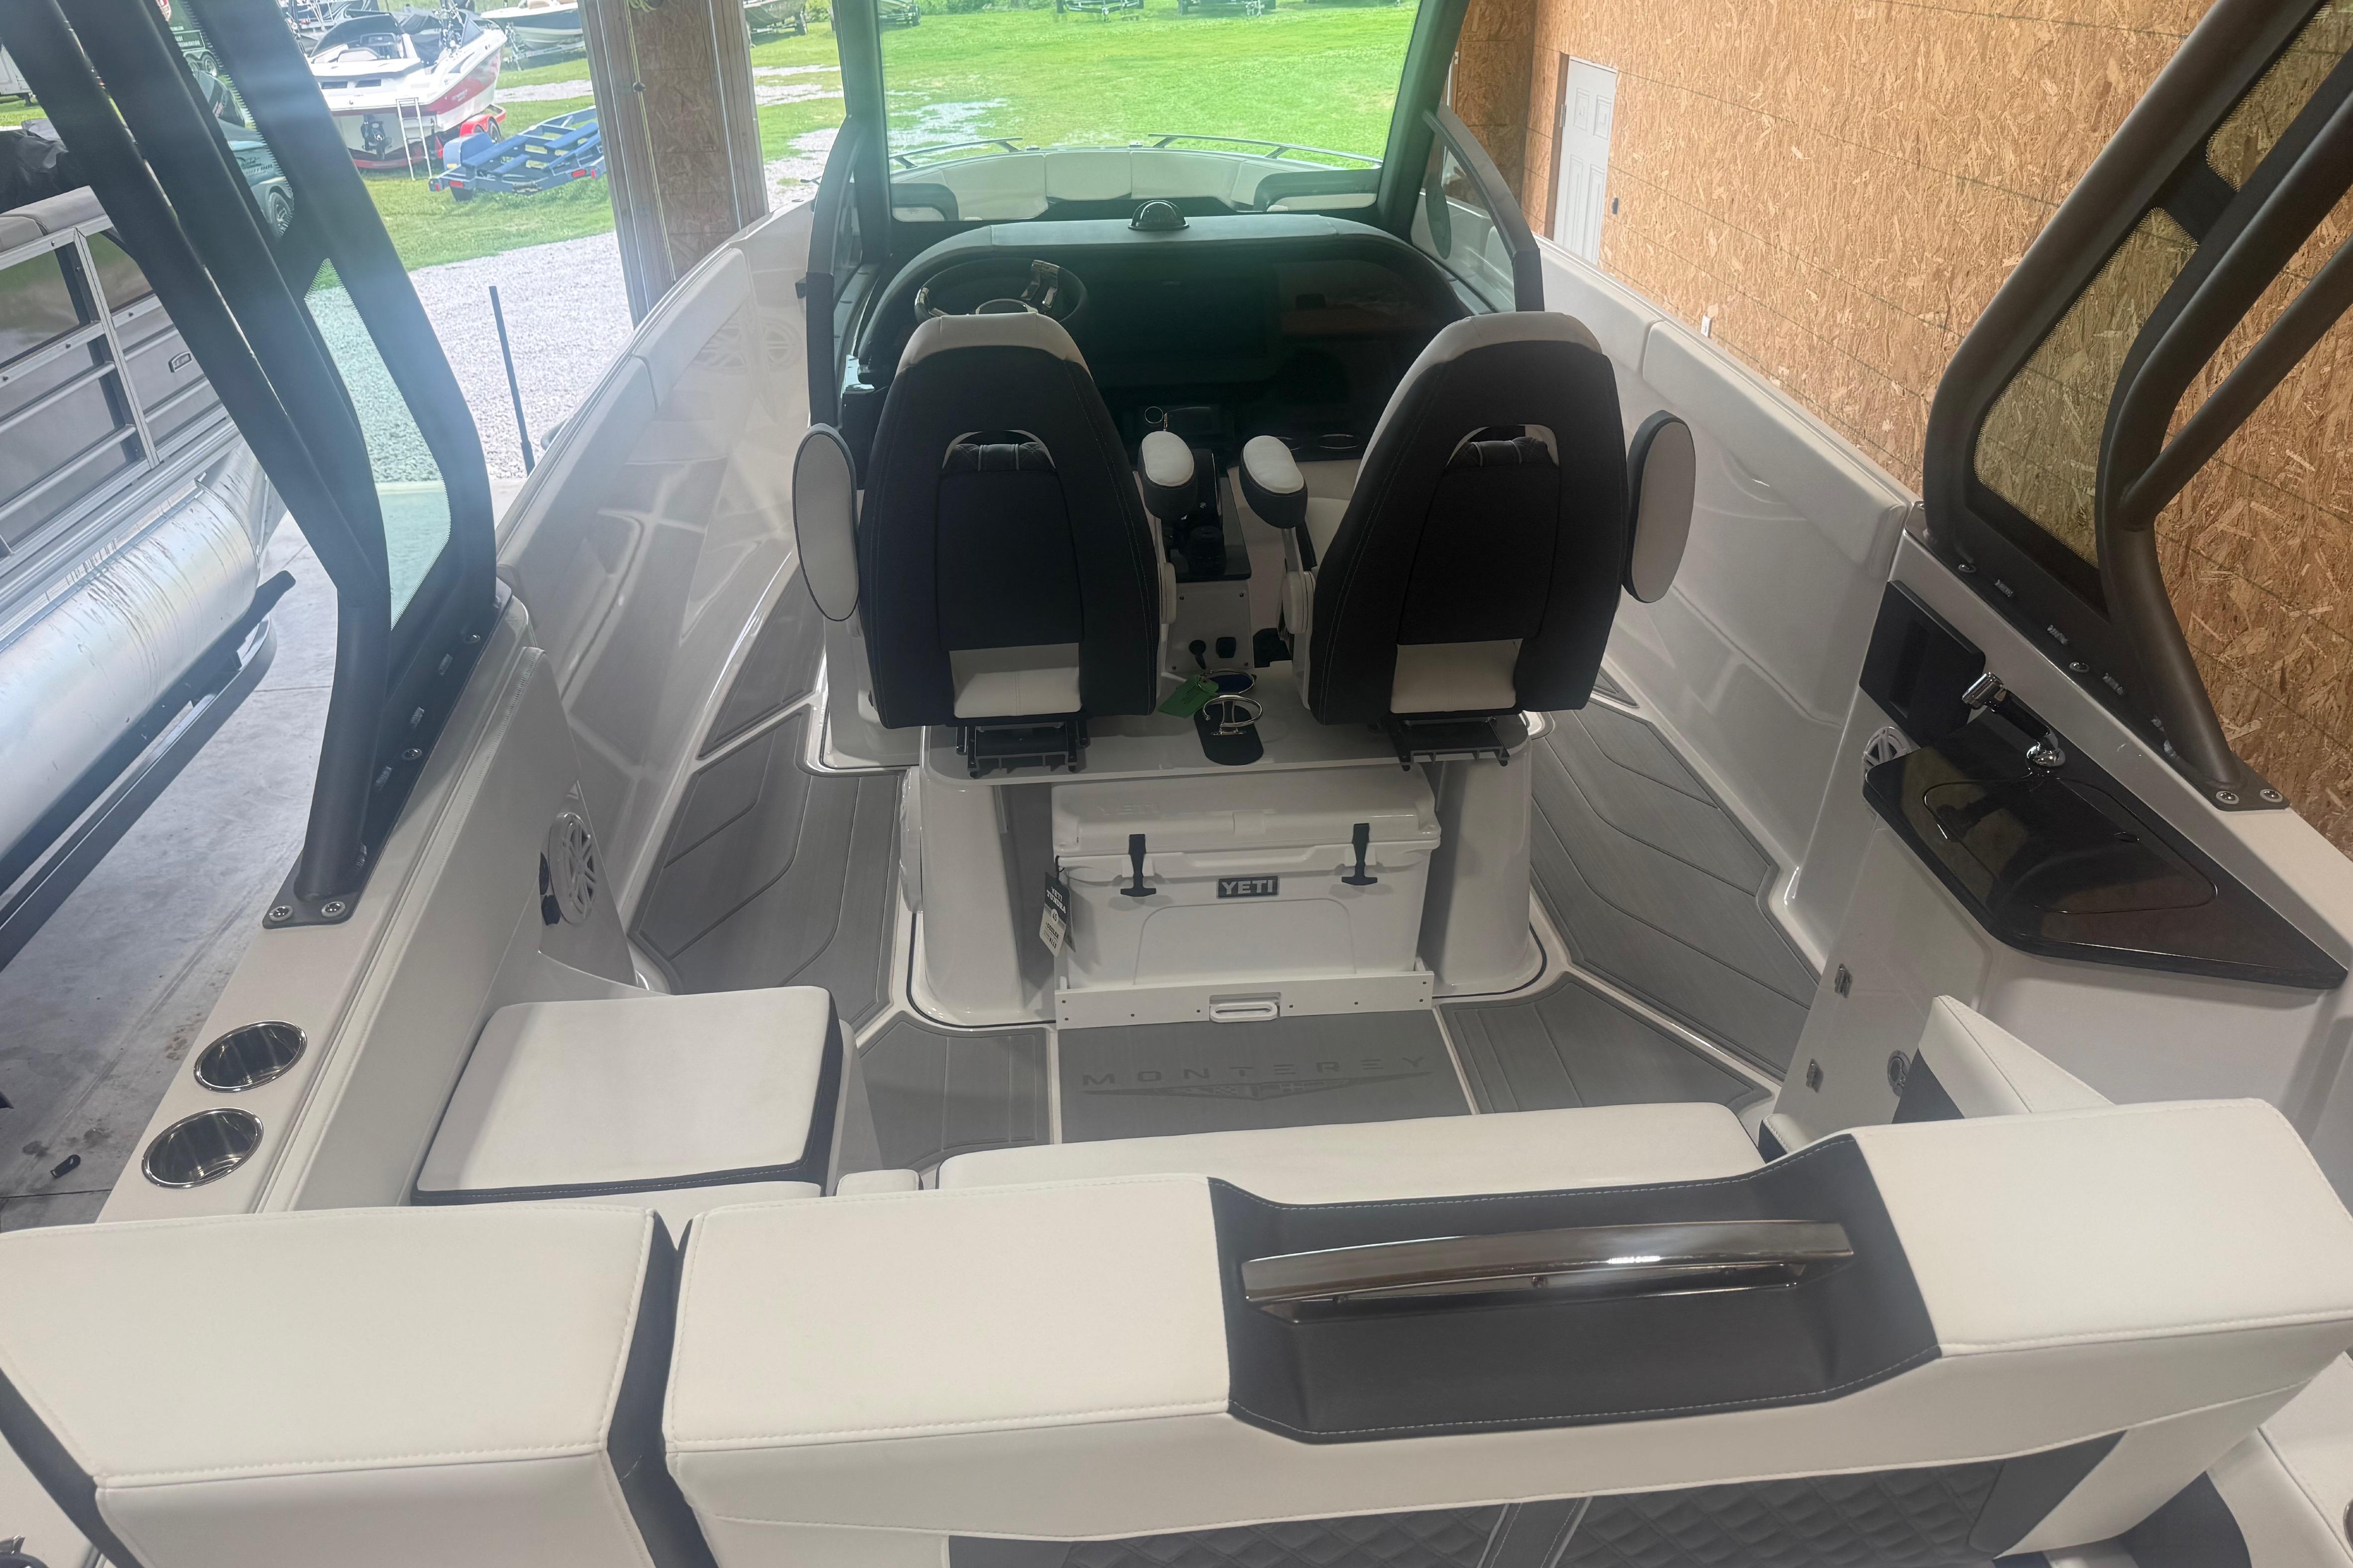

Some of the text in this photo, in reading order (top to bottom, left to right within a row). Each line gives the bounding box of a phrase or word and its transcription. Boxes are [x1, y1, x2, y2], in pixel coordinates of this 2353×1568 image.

[1051, 886, 1062, 902] YETI
[1222, 880, 1273, 894] YETI
[1047, 889, 1066, 913] TUNDRA
[1082, 1056, 1425, 1086] MONTEREY
